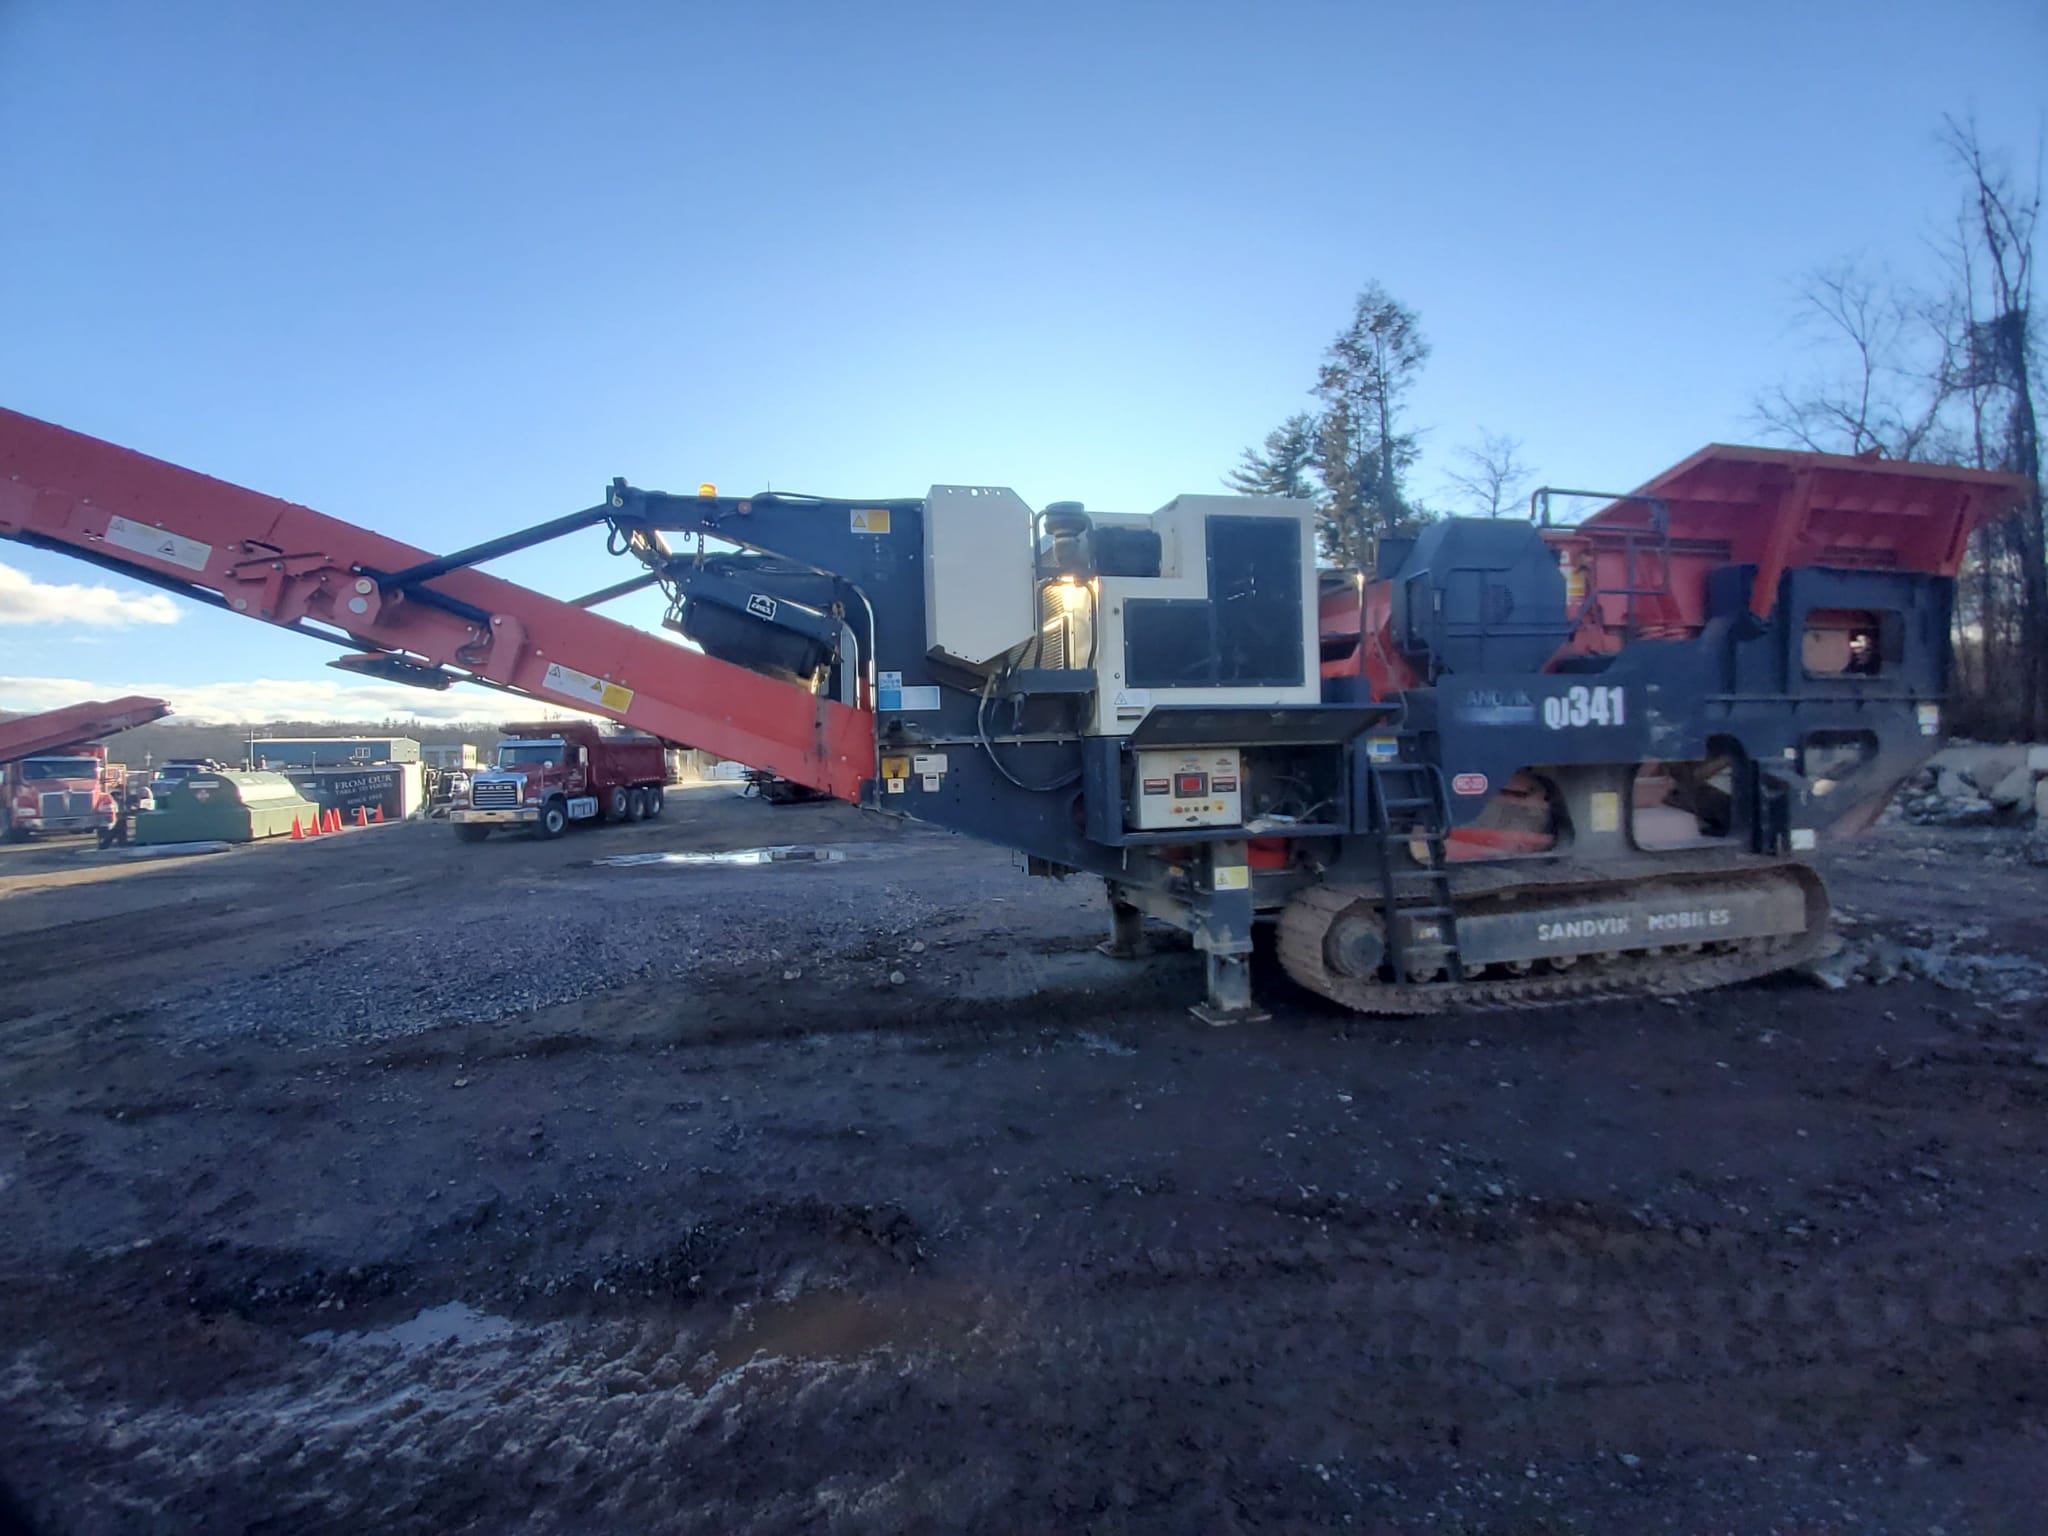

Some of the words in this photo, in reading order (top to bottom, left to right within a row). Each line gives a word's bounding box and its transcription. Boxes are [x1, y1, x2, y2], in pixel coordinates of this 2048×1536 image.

[1544, 686, 1625, 730] QJ341
[335, 778, 366, 790] FROM
[368, 774, 392, 784] OUR
[1538, 915, 1631, 941] SANDVIK
